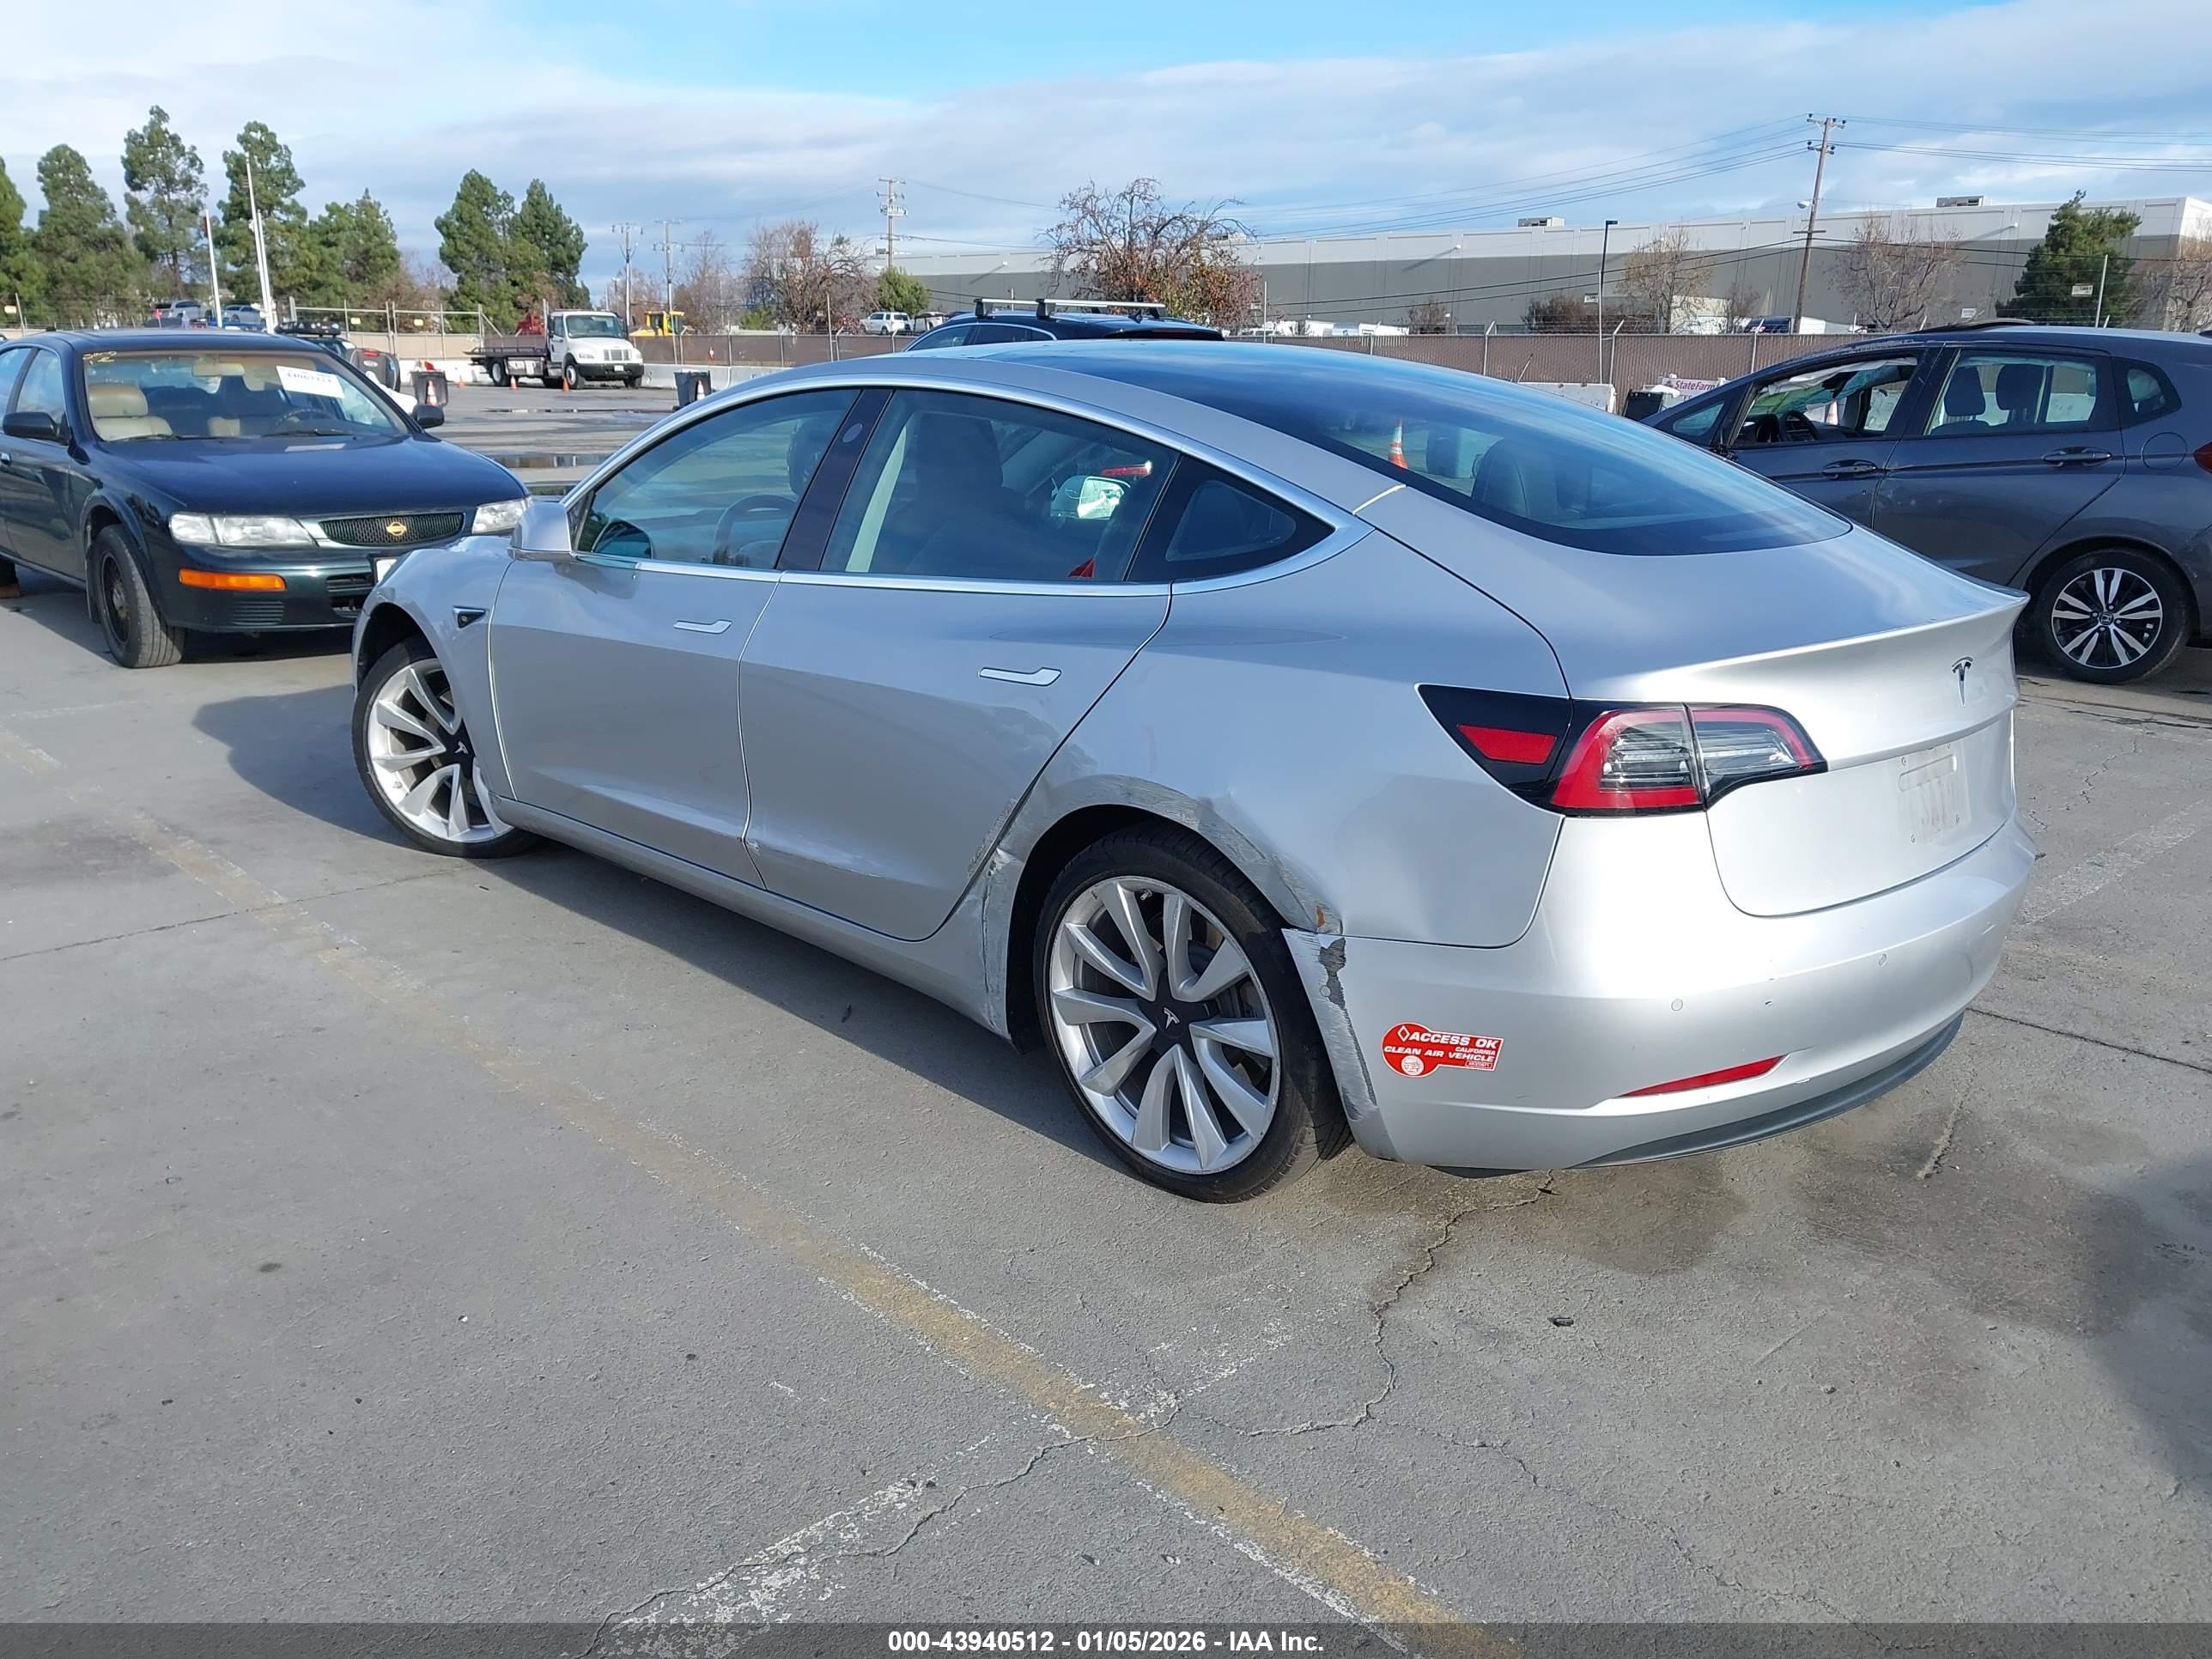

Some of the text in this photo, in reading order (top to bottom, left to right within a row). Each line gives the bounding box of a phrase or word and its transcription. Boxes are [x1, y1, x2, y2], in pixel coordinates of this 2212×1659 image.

[1408, 1031, 1500, 1049] ACCESS OK
[1383, 1045, 1495, 1062] CLEAN AIR VEHICLE
[1455, 1046, 1495, 1055] CALIFORNIA
